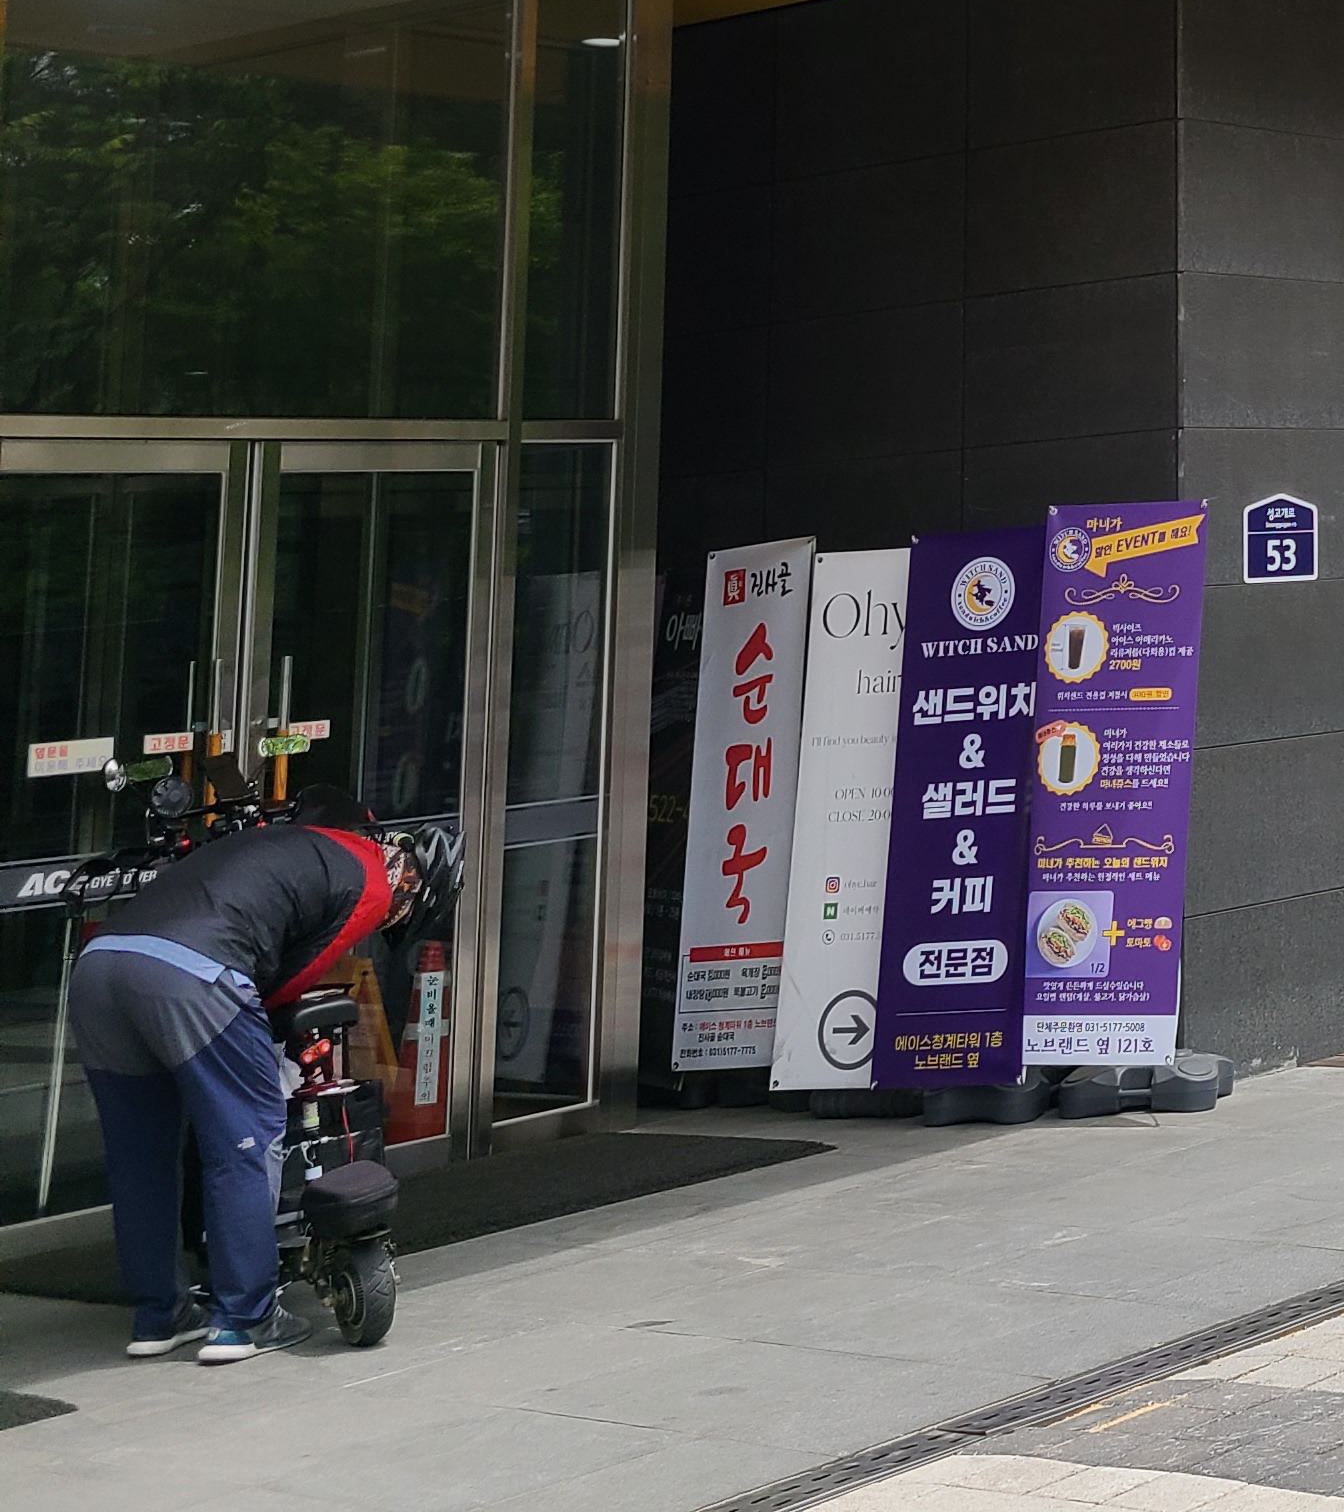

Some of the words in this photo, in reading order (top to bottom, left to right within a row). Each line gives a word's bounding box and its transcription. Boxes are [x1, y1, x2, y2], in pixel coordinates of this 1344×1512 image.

[1267, 539, 1296, 571] 53
[921, 638, 983, 659] WITCH
[986, 634, 1039, 653] SAND
[1109, 659, 1141, 670] 2700원
[912, 681, 1037, 726] 샌드위치
[959, 733, 985, 769] &
[722, 622, 774, 924] 순대국
[835, 788, 866, 801] OPEN
[922, 778, 1016, 820] 샐러드
[952, 829, 978, 865] &
[930, 875, 994, 915] 커피
[919, 947, 995, 980] 전문점
[1090, 963, 1105, 973] 1/2
[984, 1031, 1003, 1047] 1층
[1024, 1037, 1089, 1055] 노브랜드
[1096, 1036, 1110, 1055] 옆
[1117, 1038, 1154, 1053] 121호
[914, 1053, 963, 1070] 노브랜드
[967, 1052, 979, 1068] 옆
